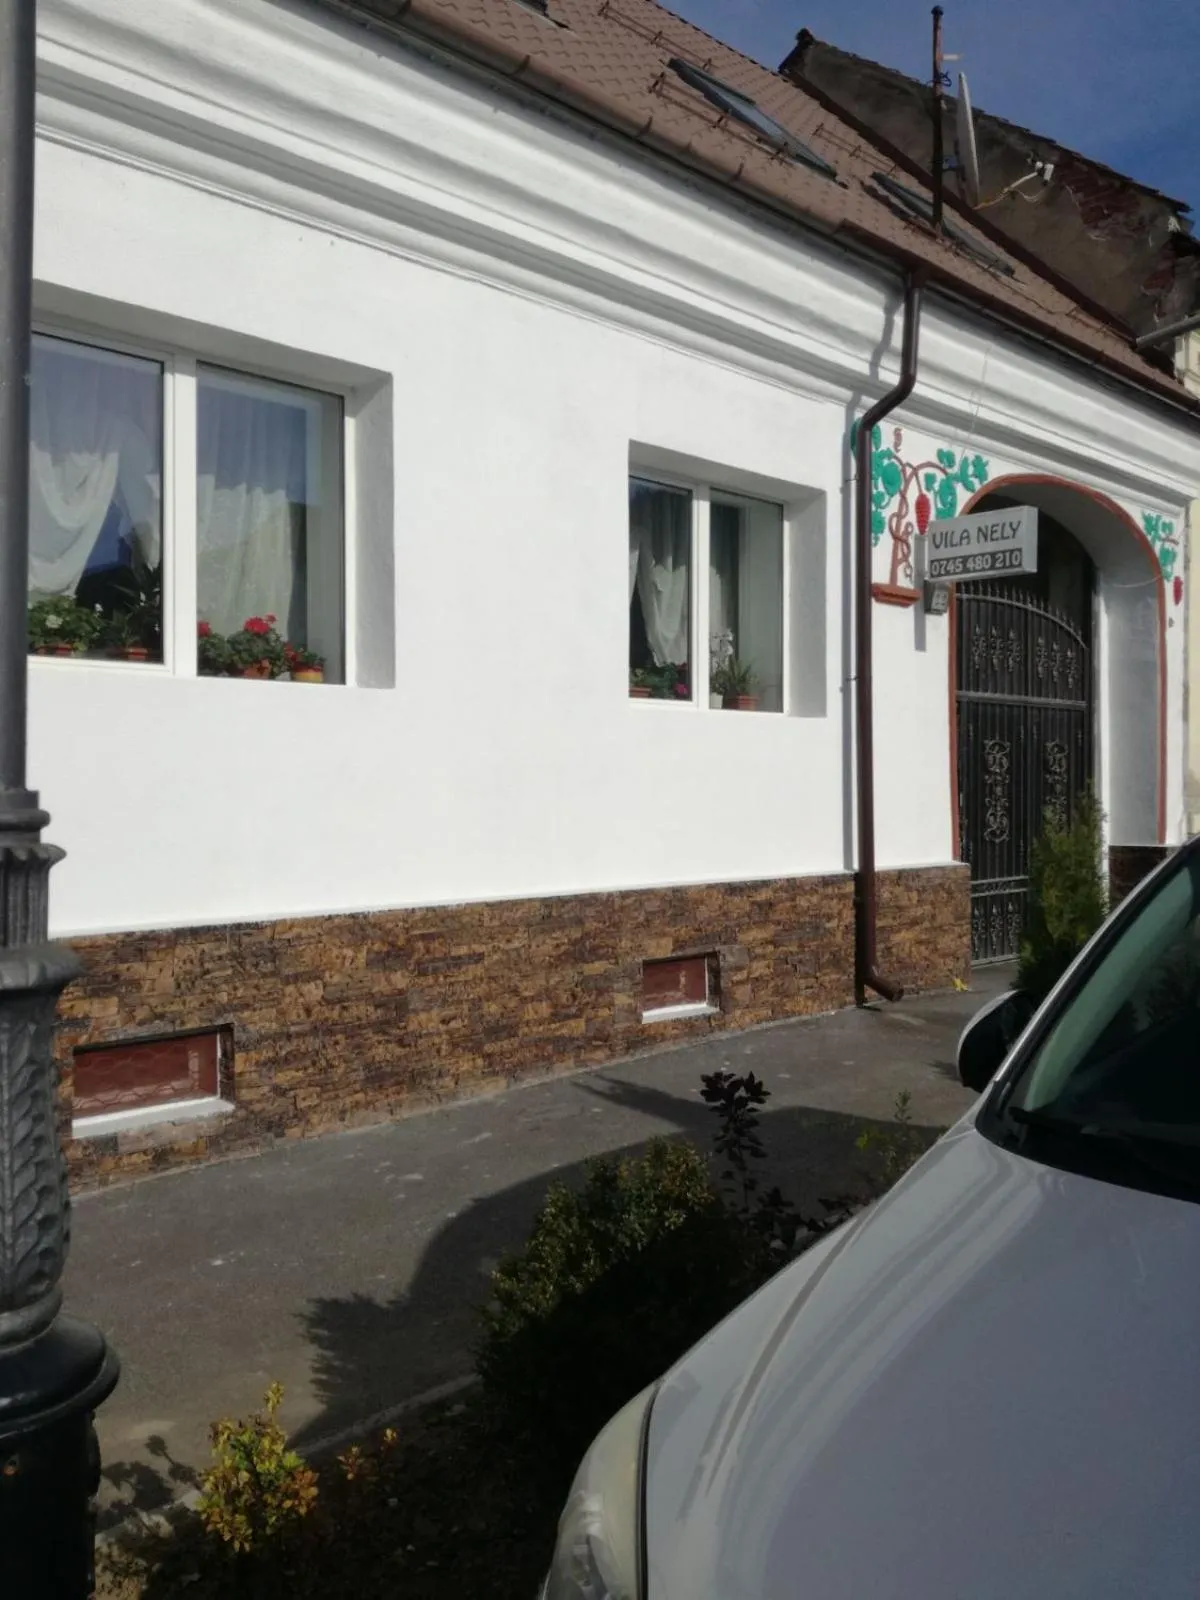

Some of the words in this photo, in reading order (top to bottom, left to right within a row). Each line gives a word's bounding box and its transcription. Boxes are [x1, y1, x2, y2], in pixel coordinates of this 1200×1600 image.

[932, 528, 971, 549] VILA
[977, 520, 1021, 543] NELY
[931, 558, 963, 576] 0745
[966, 553, 991, 571] 480
[994, 550, 1021, 568] 210
